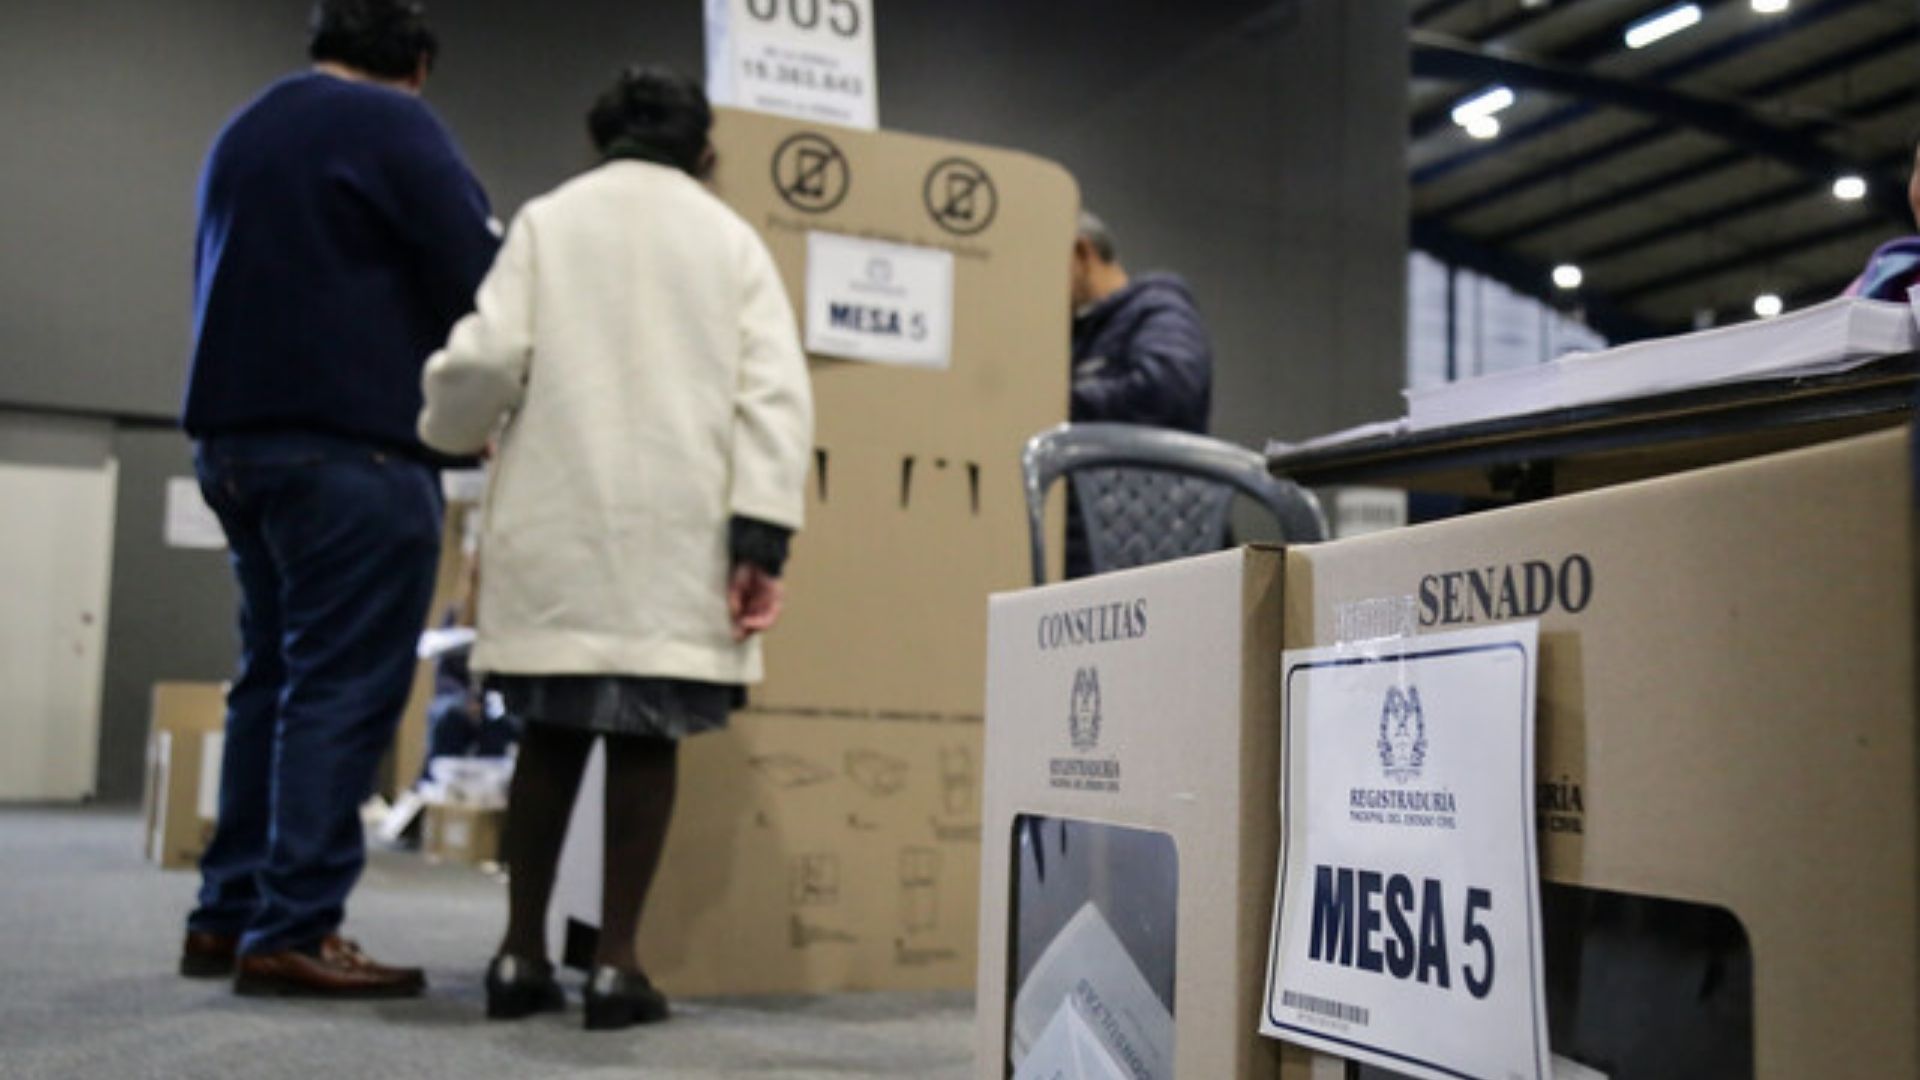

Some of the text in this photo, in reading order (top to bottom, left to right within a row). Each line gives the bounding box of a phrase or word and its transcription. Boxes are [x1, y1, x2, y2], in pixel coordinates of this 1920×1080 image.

[829, 302, 928, 341] MESA 5
[1418, 553, 1594, 626] SENADO
[1037, 598, 1148, 650] CONSULTAS
[1349, 786, 1456, 813] REGISTRADURÍA
[1308, 864, 1496, 1000] MESA 5
